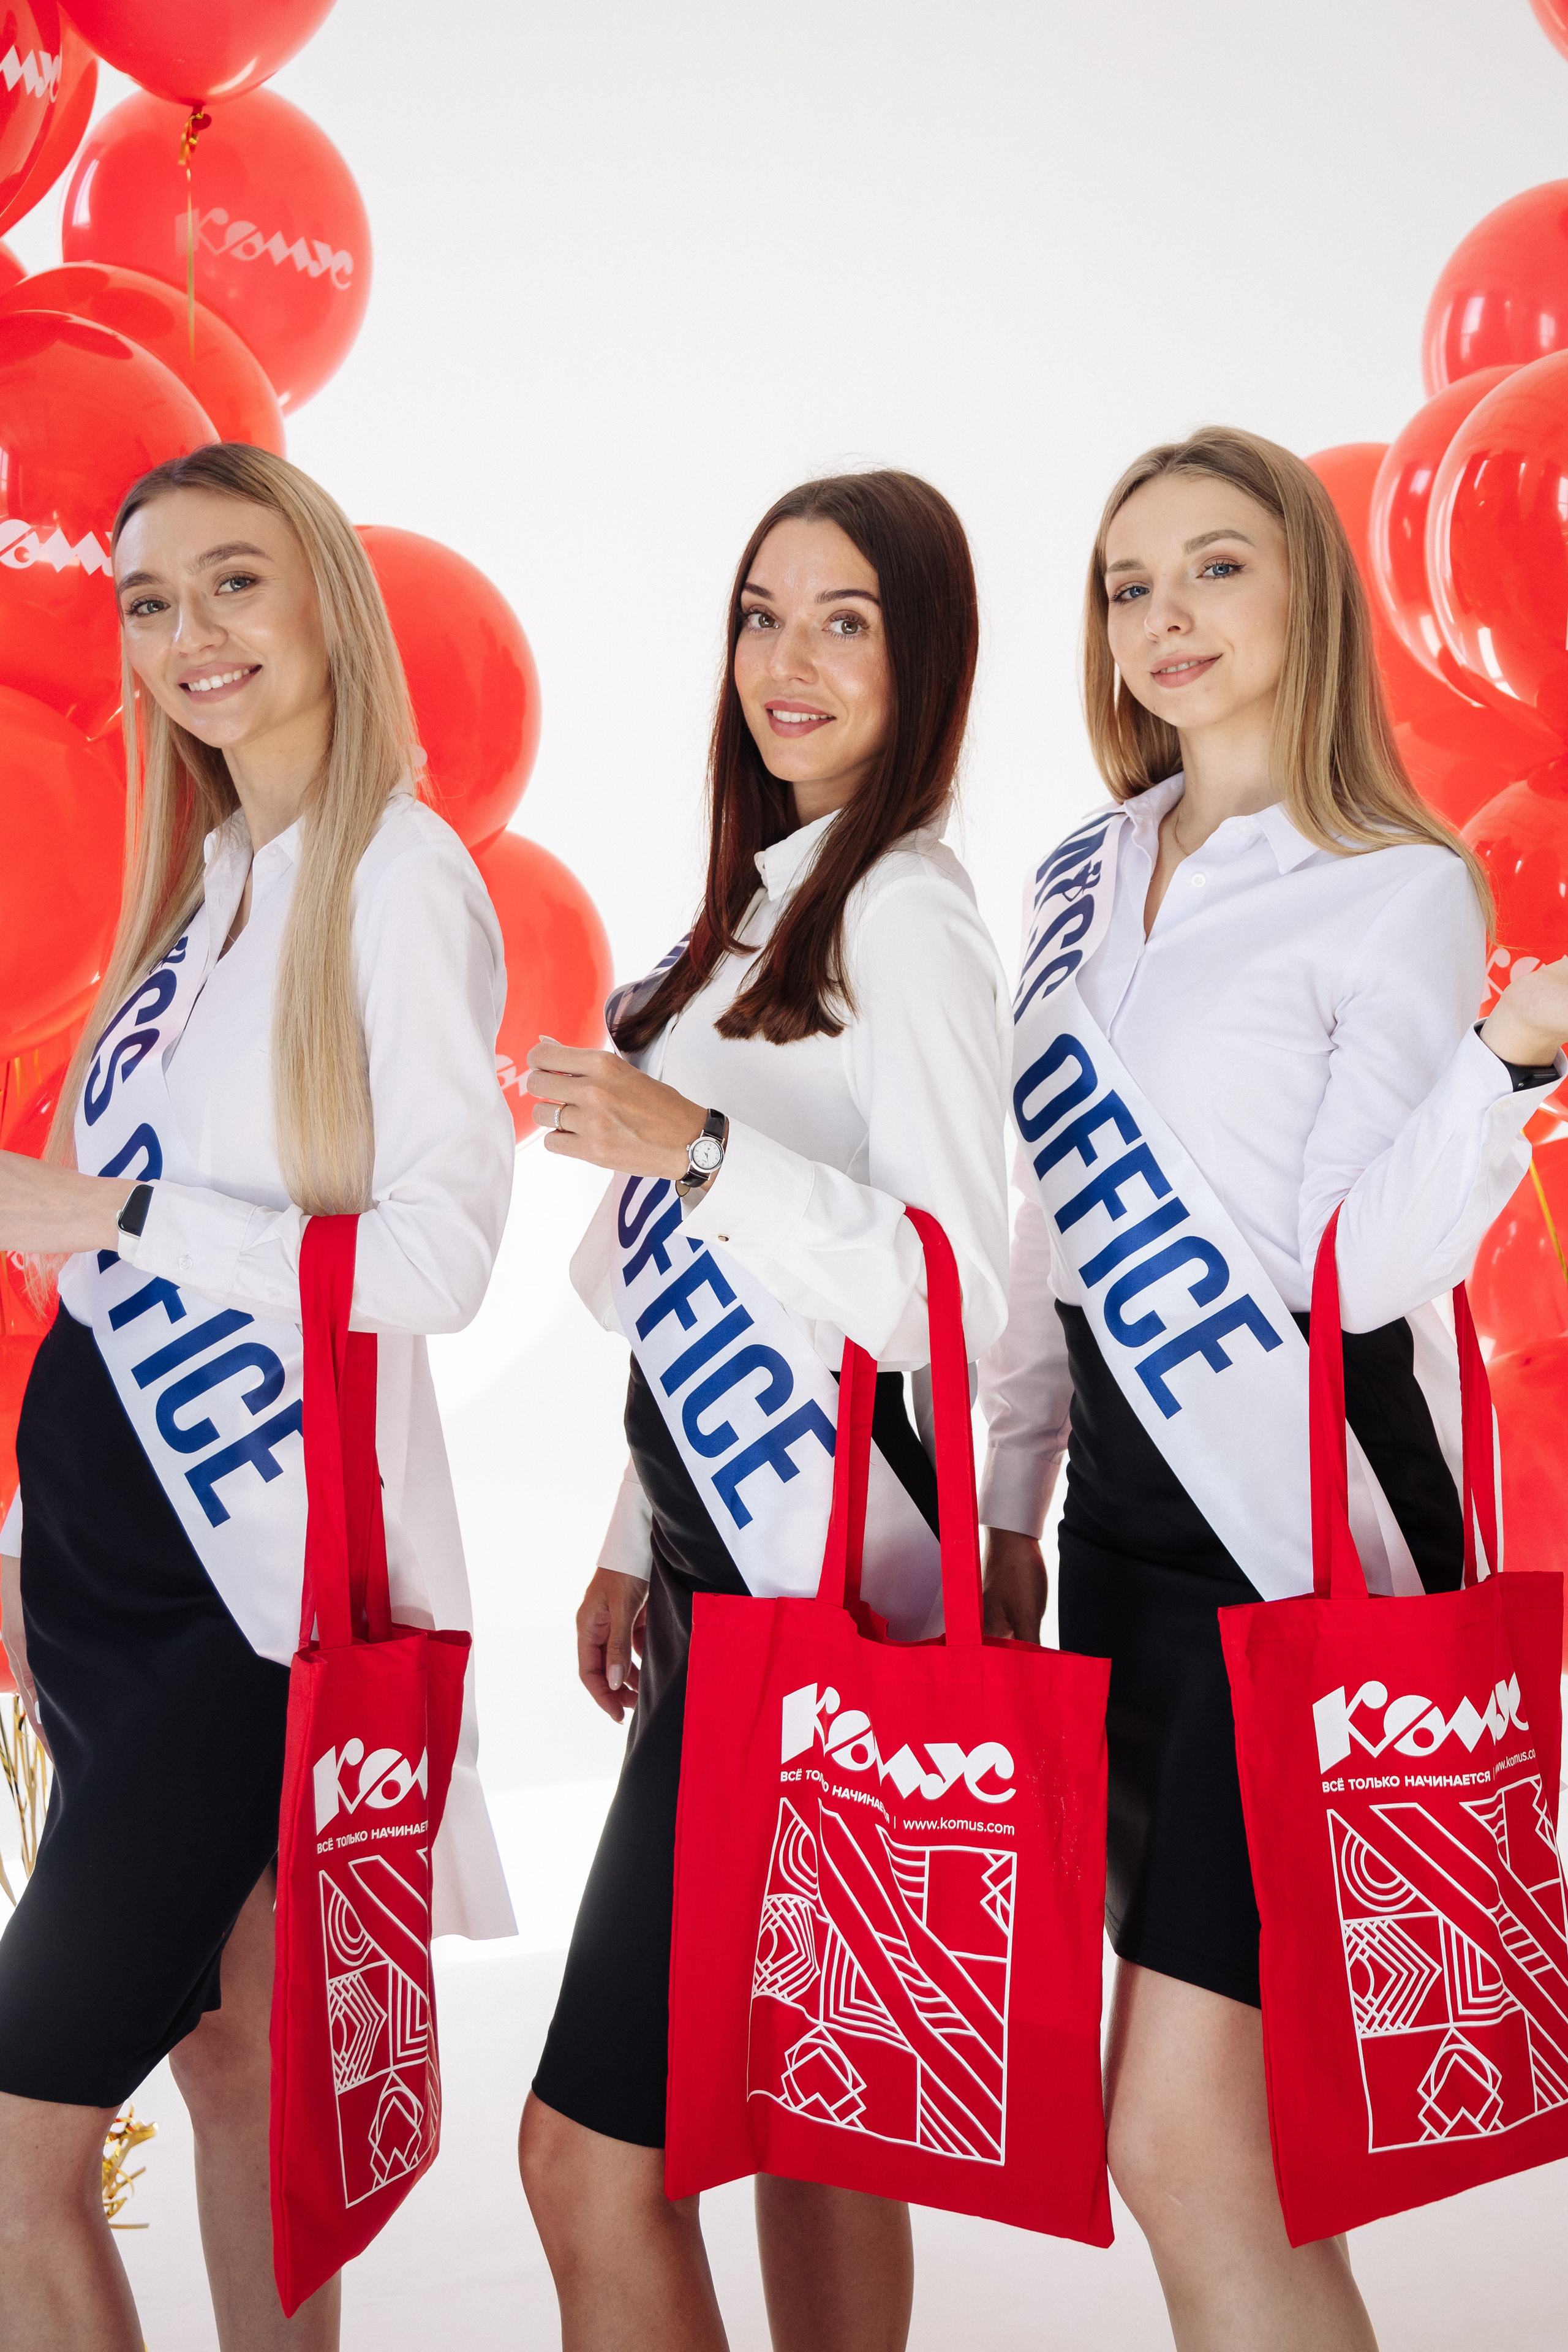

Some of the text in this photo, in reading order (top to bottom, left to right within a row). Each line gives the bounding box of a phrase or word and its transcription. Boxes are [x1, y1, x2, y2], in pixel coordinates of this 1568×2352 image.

[174, 206, 355, 291] Комус
[1014, 1034, 1283, 1419] OFFICE
[780, 1683, 1017, 1803] Комус
[781, 1768, 802, 1781] ВСЁ
[903, 1817, 1014, 1835] www.komus.com
[1322, 1777, 1344, 1792] ВСЁ
[1348, 1776, 1400, 1790] ТОЛЬКО
[1405, 1771, 1490, 1787] НАЧИНАЕТСЯ
[317, 1838, 333, 1853] ВСЁ
[336, 1831, 368, 1848] ТОЛЬКО
